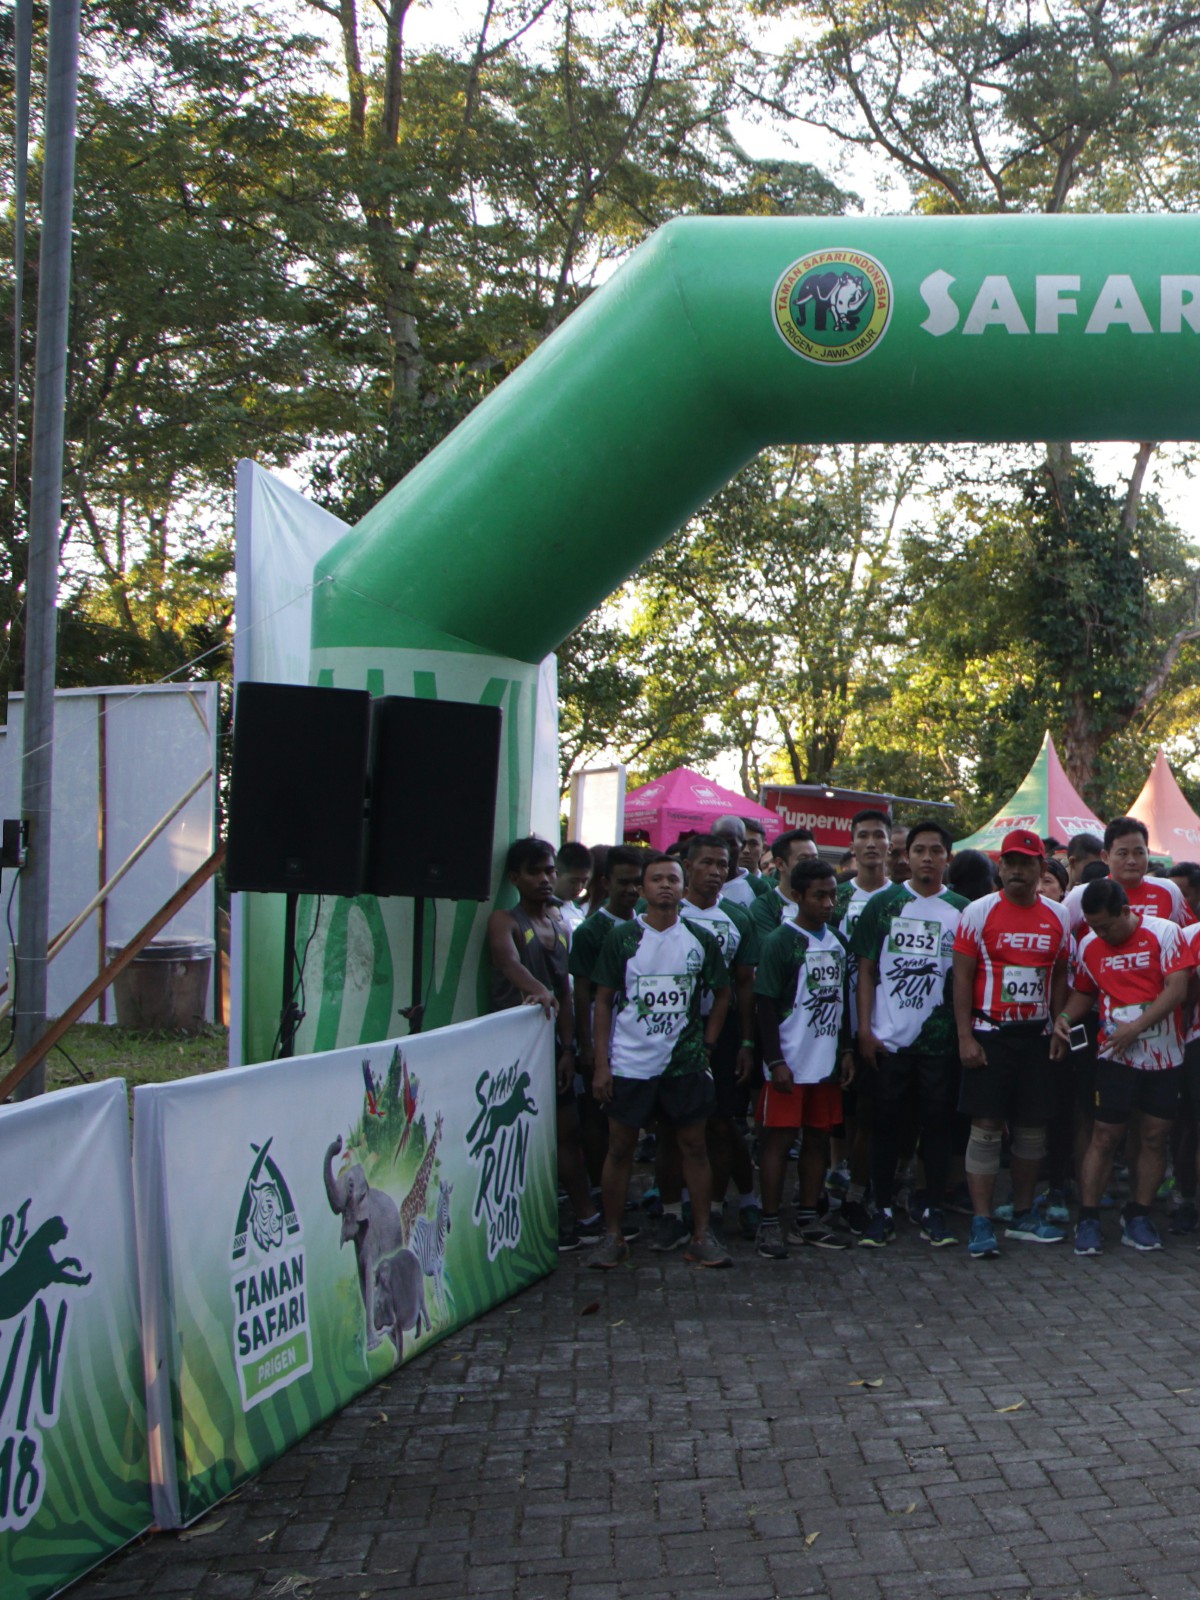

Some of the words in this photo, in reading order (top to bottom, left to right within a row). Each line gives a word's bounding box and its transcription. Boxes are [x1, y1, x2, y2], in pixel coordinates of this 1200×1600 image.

[779, 268, 803, 311] TAMAN
[803, 253, 847, 271] SAFARI
[848, 254, 888, 310] INDONESIA
[783, 321, 814, 353] PRIGEN
[820, 348, 850, 359] JAWA
[848, 328, 879, 354] TIMUR
[894, 932, 935, 951] 0252
[1001, 932, 1052, 951] PETE
[886, 957, 929, 976] SAFARI
[1104, 950, 1151, 971] PETE
[644, 991, 688, 1007] 0491
[890, 977, 936, 1002] RUN
[1007, 980, 1044, 997] 0479
[899, 995, 924, 1010] 2018
[647, 1021, 673, 1036] 2018
[466, 1057, 520, 1145] SAFARI
[475, 1117, 530, 1220] RUN
[490, 1193, 520, 1254] 2018
[235, 1253, 304, 1315] TAMAN
[237, 1291, 305, 1356] SAFARI
[256, 1345, 297, 1385] PRIGEN
